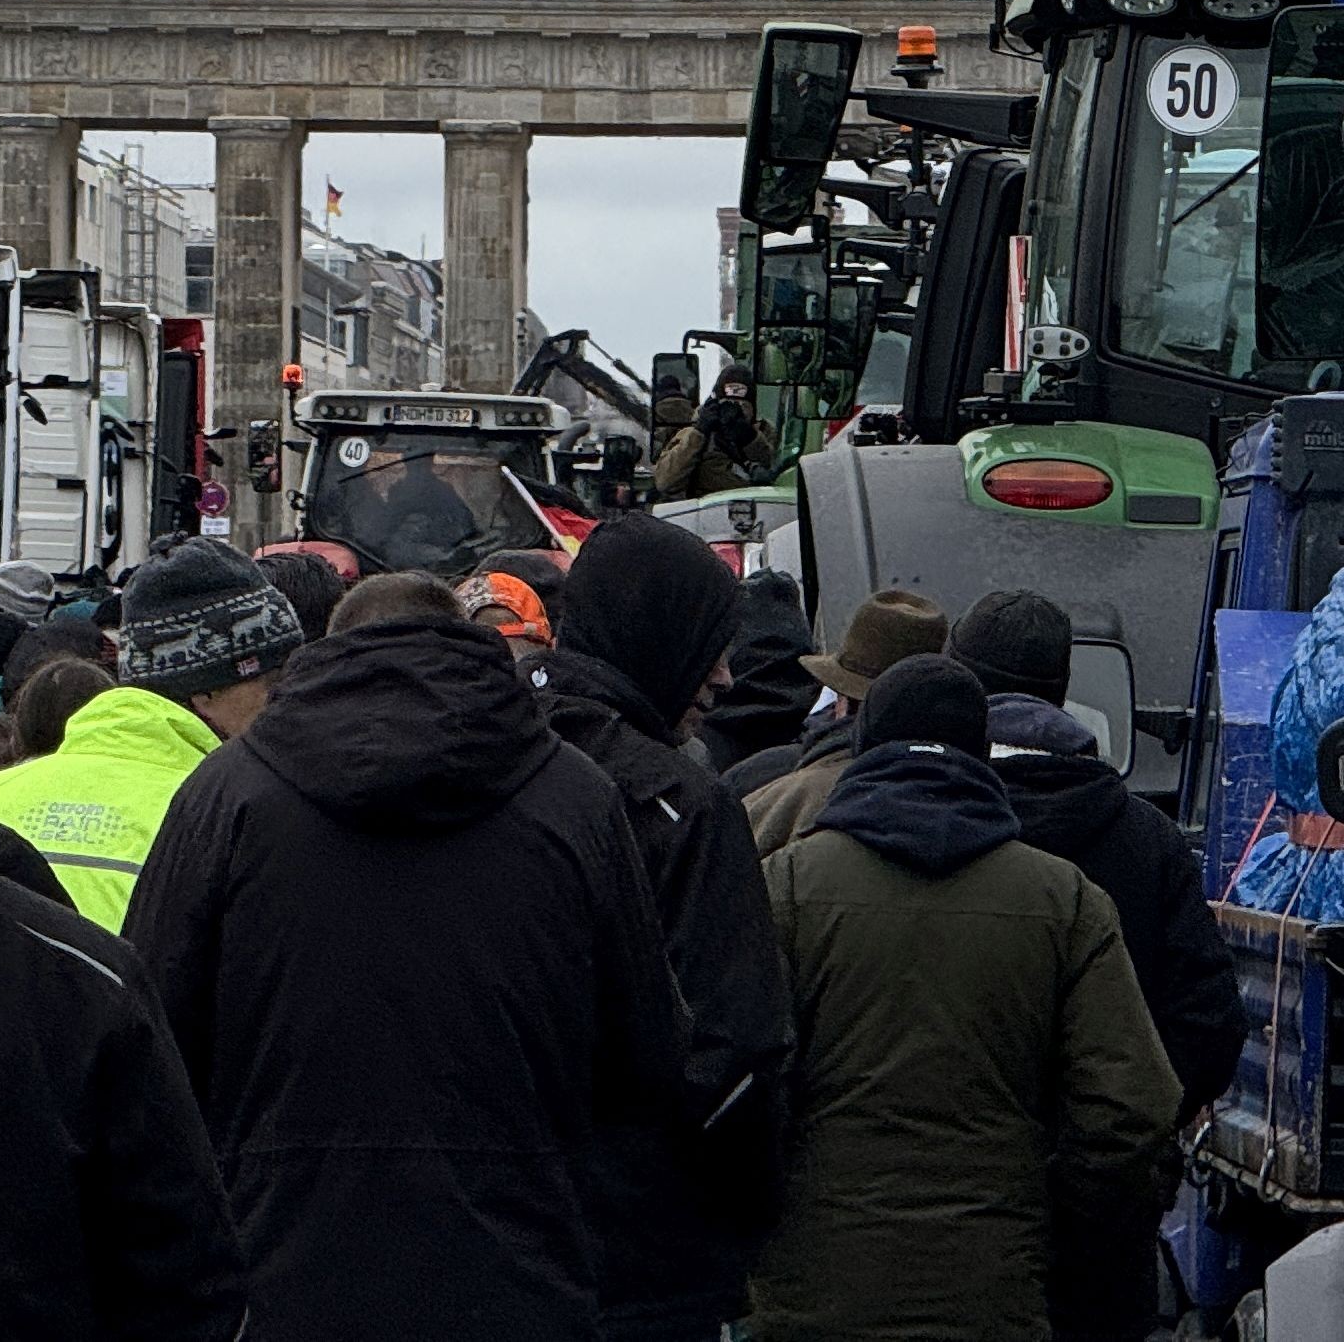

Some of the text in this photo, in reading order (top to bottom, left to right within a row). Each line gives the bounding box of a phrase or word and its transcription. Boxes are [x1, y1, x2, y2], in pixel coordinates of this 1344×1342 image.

[1167, 62, 1218, 119] 50
[345, 438, 363, 460] 40
[43, 814, 103, 832] RAIN
